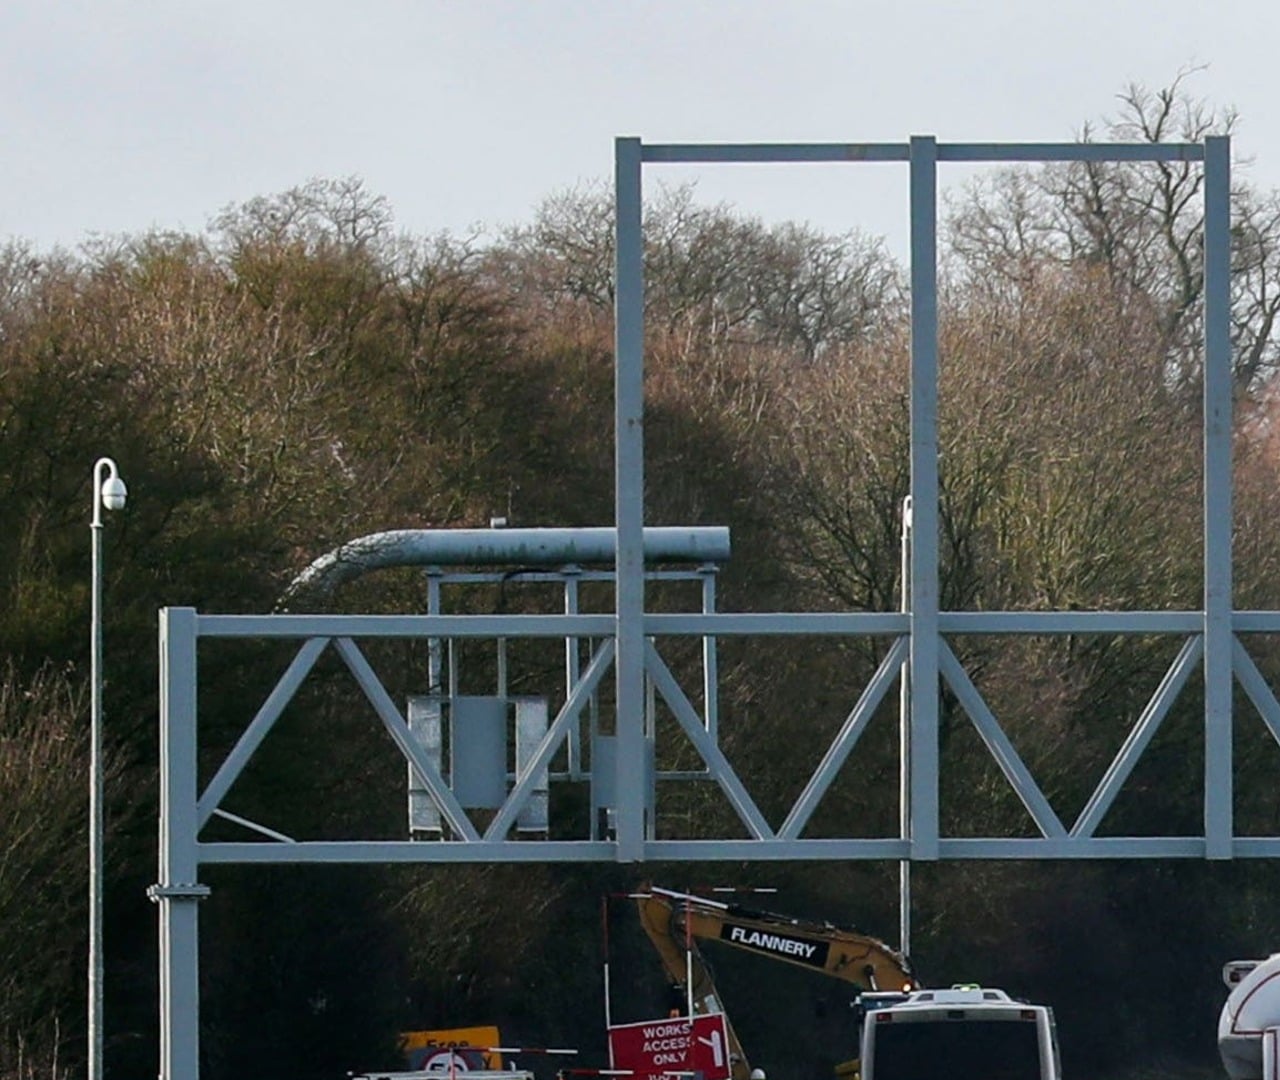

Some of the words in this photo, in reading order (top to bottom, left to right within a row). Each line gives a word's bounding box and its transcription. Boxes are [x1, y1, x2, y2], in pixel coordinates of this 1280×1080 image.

[731, 927, 816, 958] FLANNERY
[643, 1024, 691, 1039] WORKS
[653, 1052, 687, 1066] ONLY
